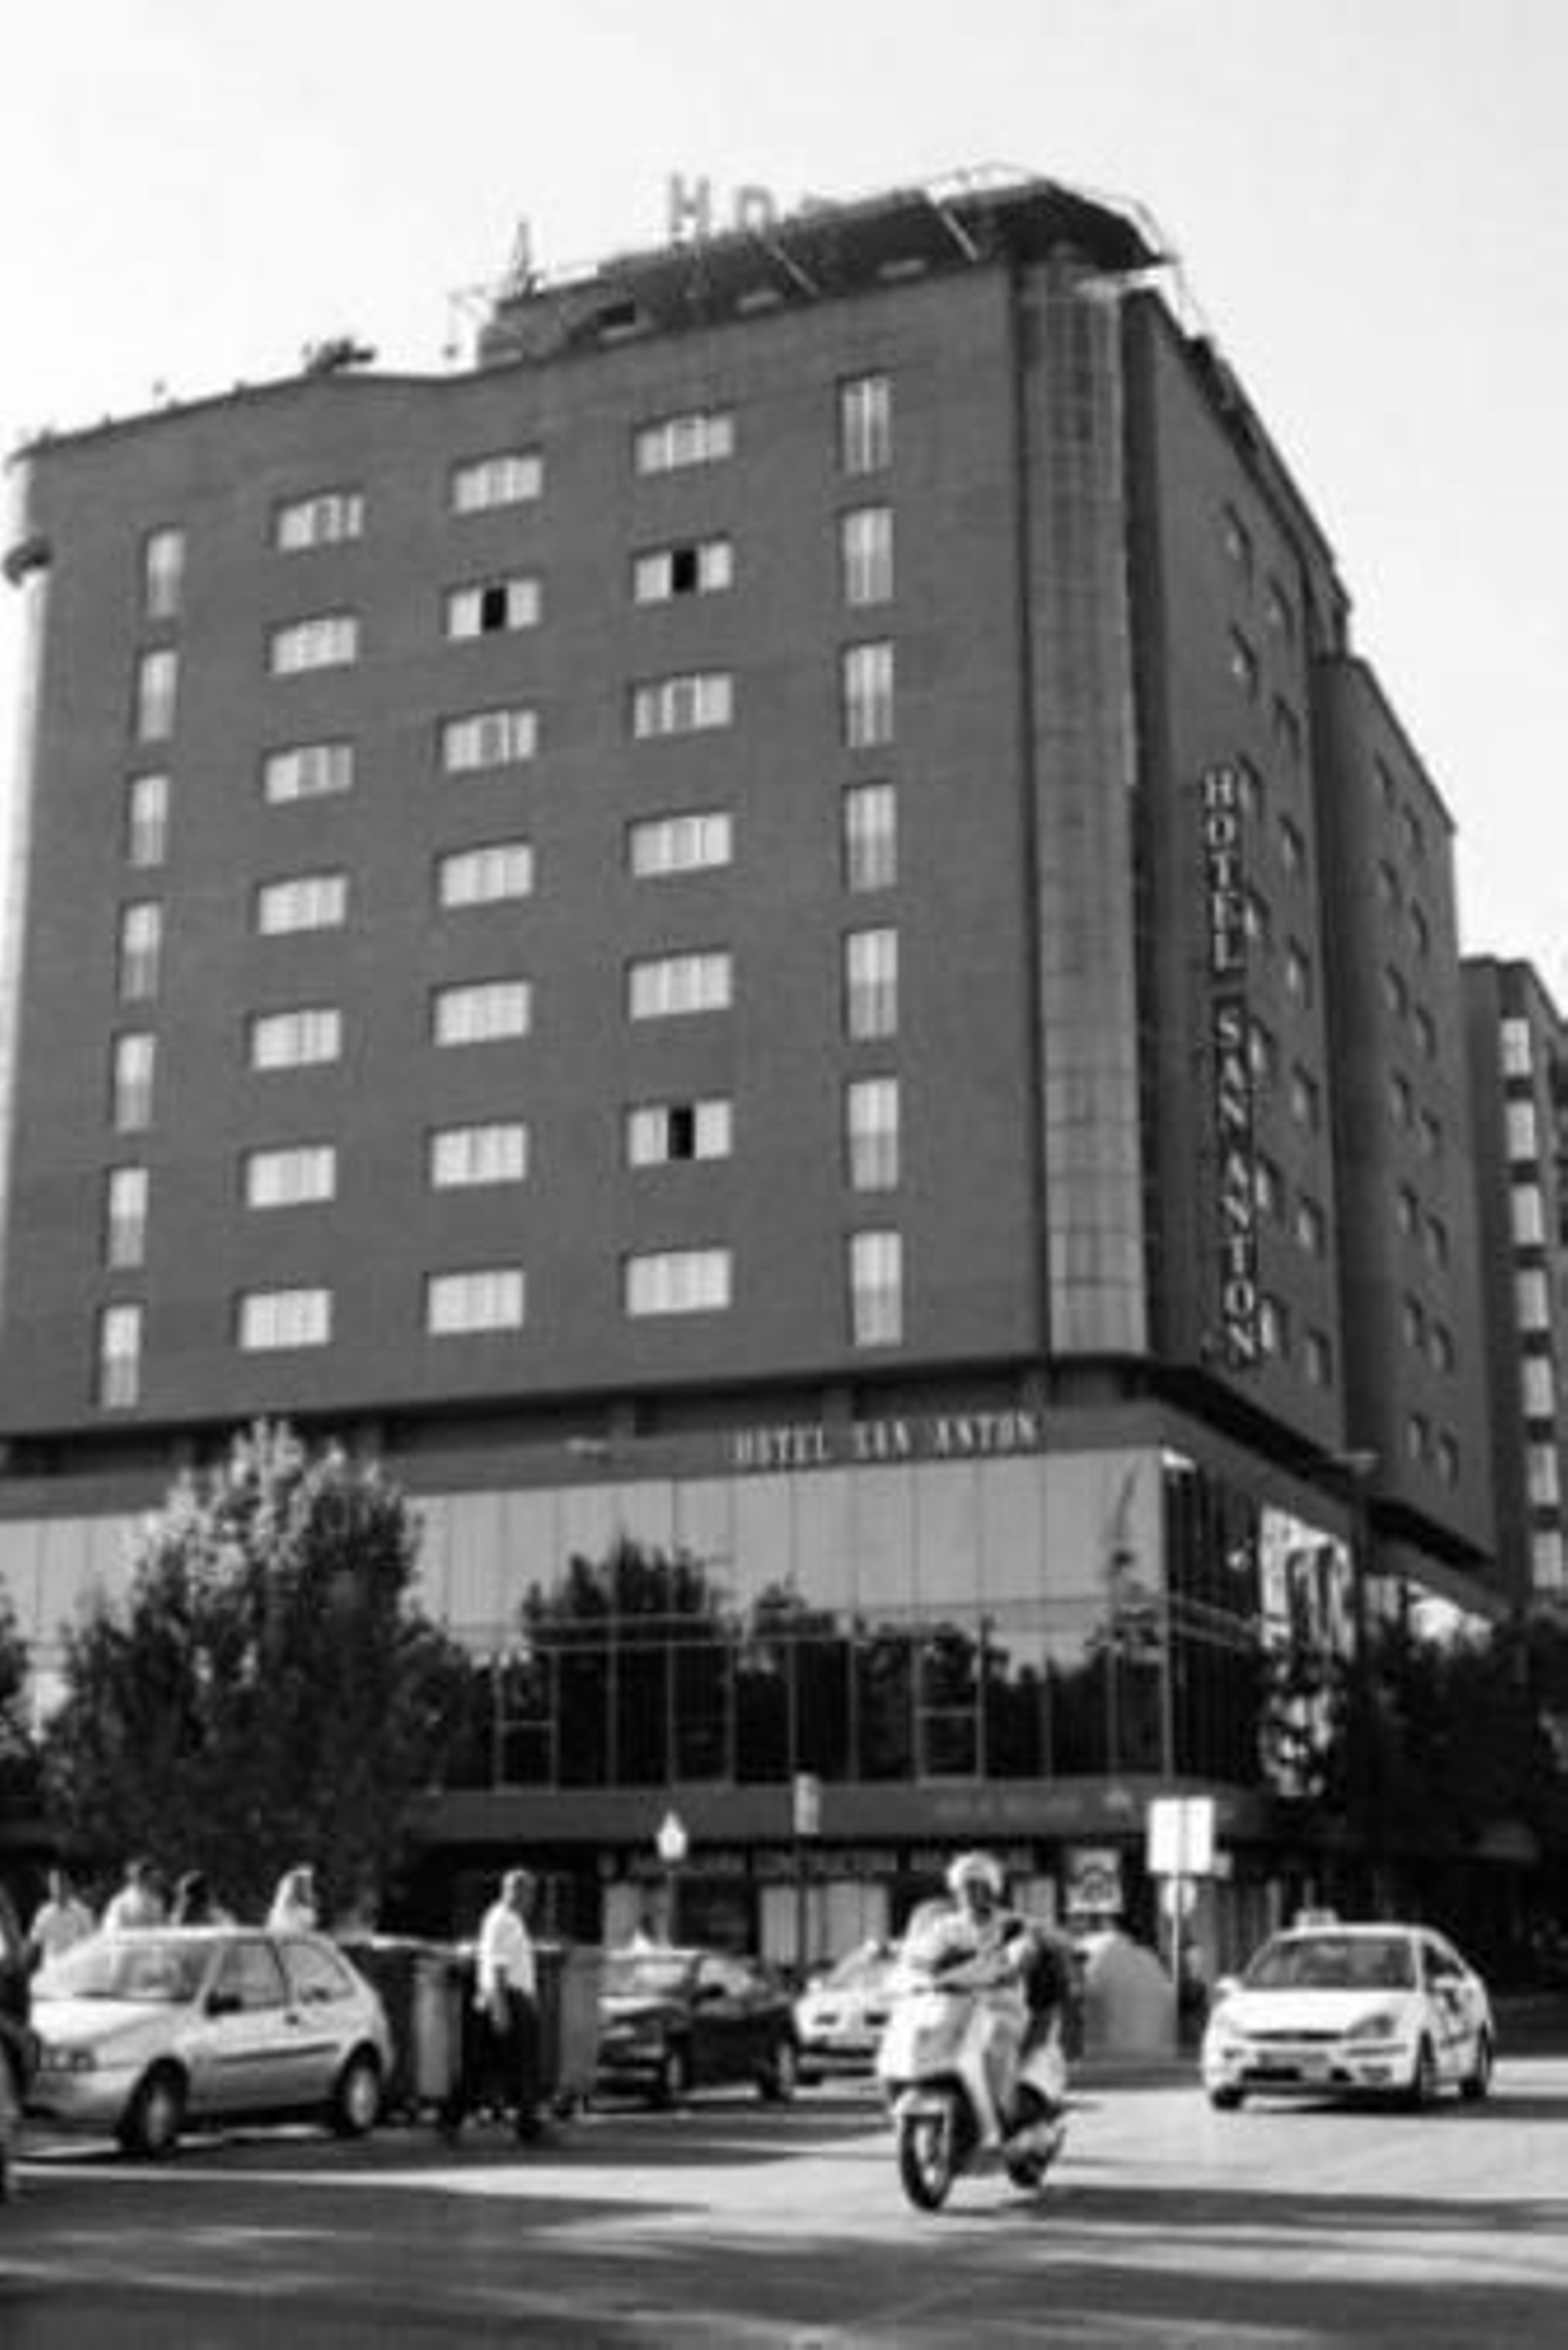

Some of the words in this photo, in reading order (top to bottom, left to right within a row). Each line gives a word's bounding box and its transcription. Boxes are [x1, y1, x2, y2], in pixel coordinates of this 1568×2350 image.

[1203, 769, 1246, 973] HOTEL
[1216, 1007, 1247, 1129] SAN
[1220, 1151, 1256, 1361] ANTON
[730, 1426, 831, 1465] HOTEL
[853, 1420, 911, 1459] SAN
[932, 1410, 1037, 1456] ANTON
